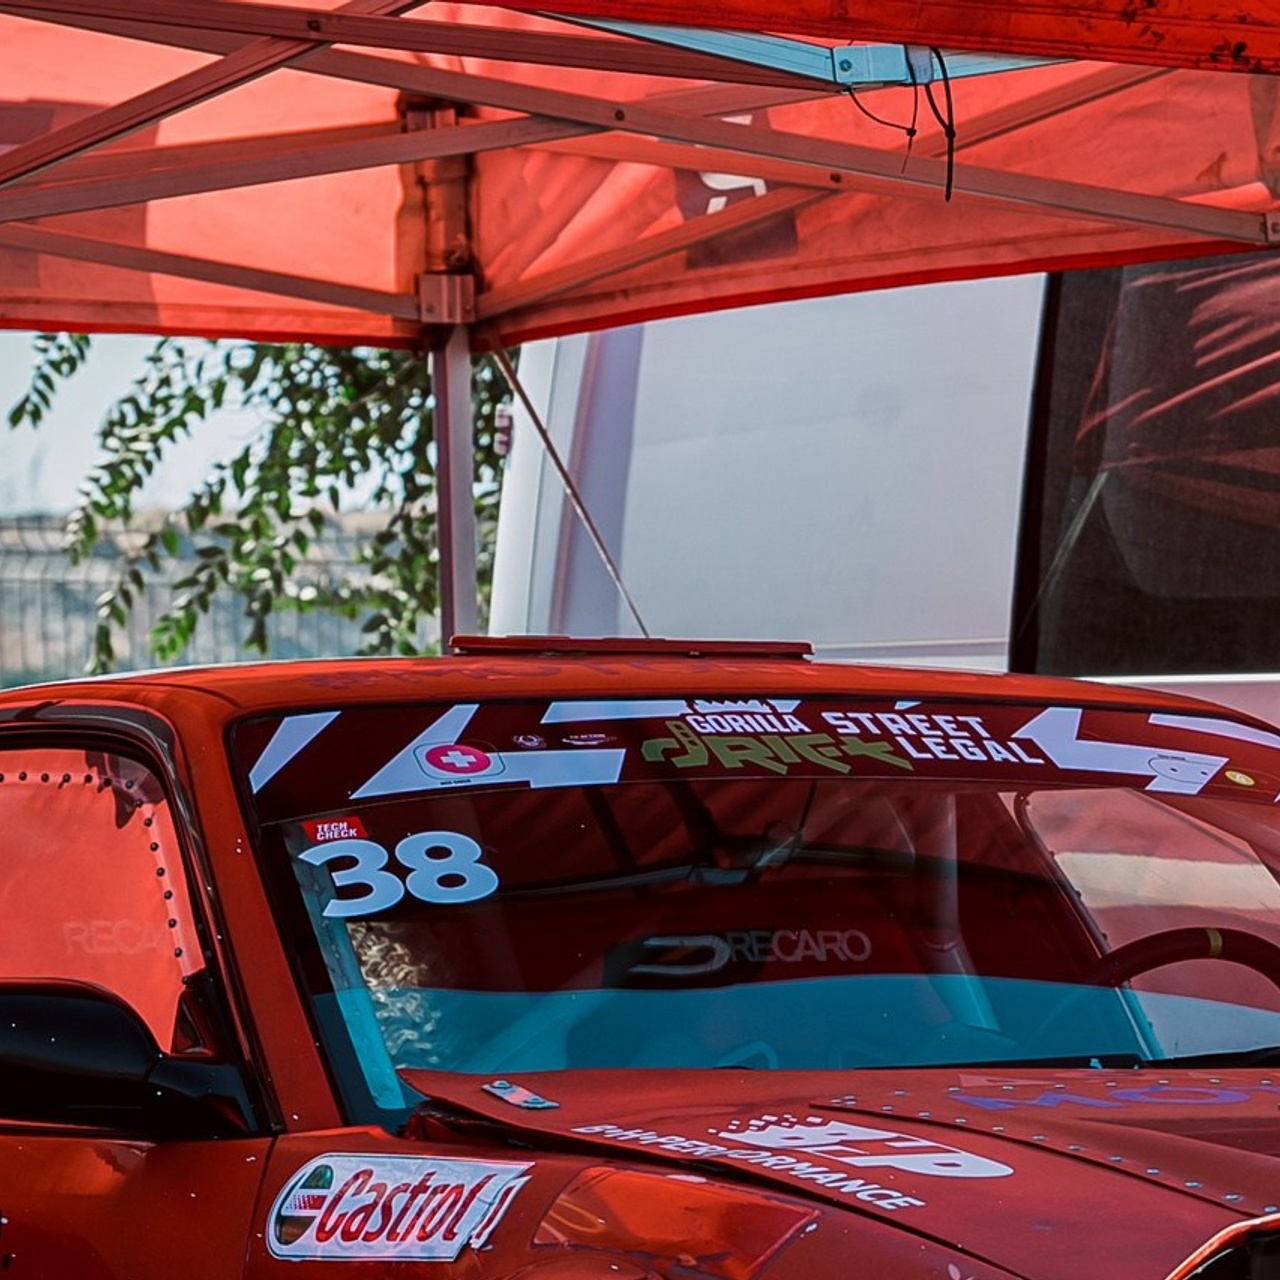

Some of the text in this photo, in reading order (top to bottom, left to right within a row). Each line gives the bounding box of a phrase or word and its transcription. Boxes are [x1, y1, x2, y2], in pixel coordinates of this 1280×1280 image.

[686, 711, 992, 738] GORILLA STREET
[895, 735, 1046, 765] LEGAL
[316, 821, 348, 833] TECH
[316, 828, 358, 841] CHECK
[297, 830, 500, 918] 38
[724, 928, 873, 963] RECARO
[314, 1167, 498, 1244] Castrol
